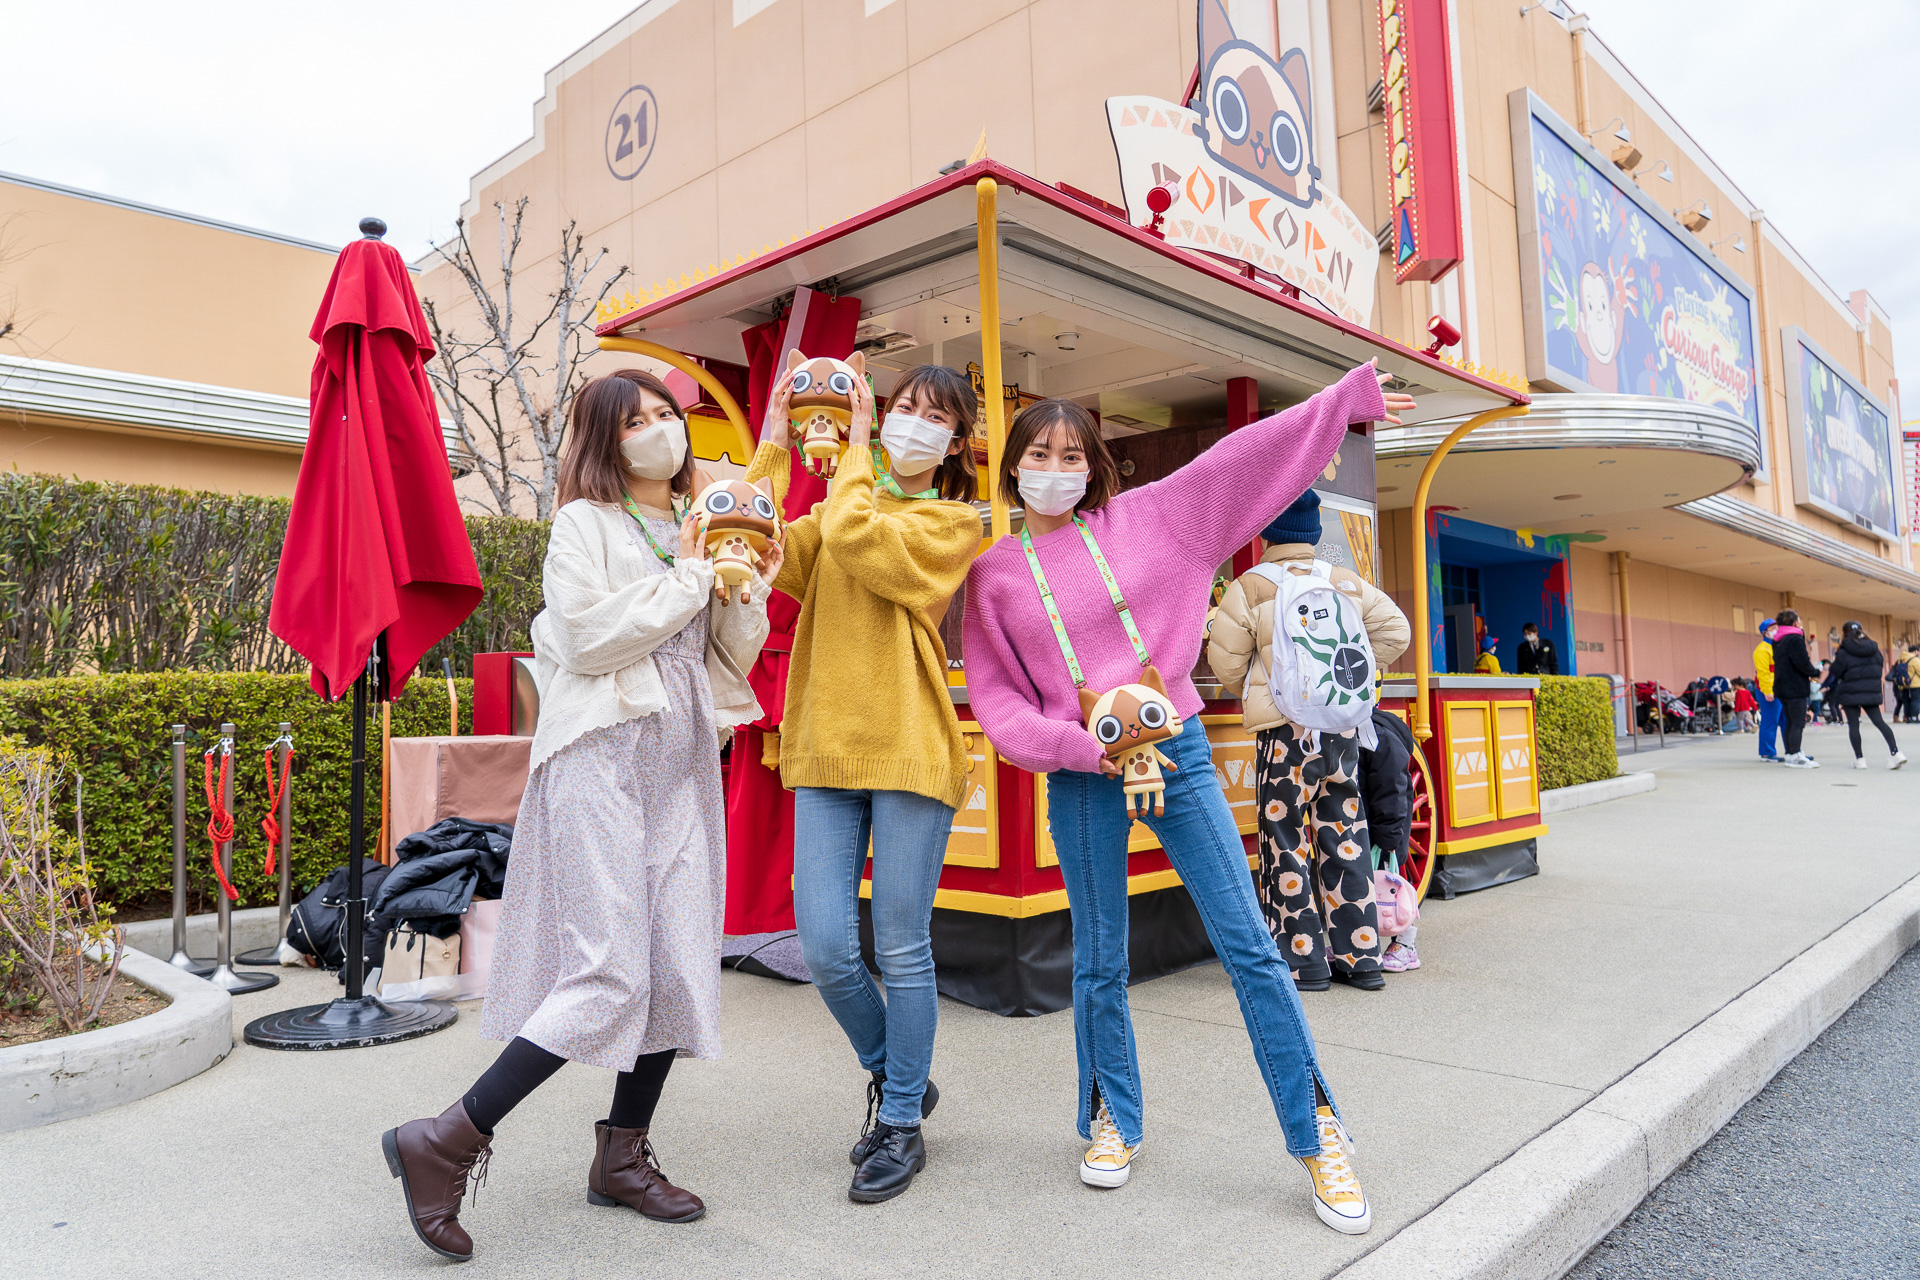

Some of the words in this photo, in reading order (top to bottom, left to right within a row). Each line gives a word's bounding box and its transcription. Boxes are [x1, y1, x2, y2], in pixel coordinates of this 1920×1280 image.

[614, 100, 648, 162] 21
[1151, 162, 1353, 293] POPCORN
[1675, 289, 1709, 324] Playing
[1710, 308, 1731, 342] with
[1663, 310, 1710, 373] Curious
[1710, 344, 1748, 402] George
